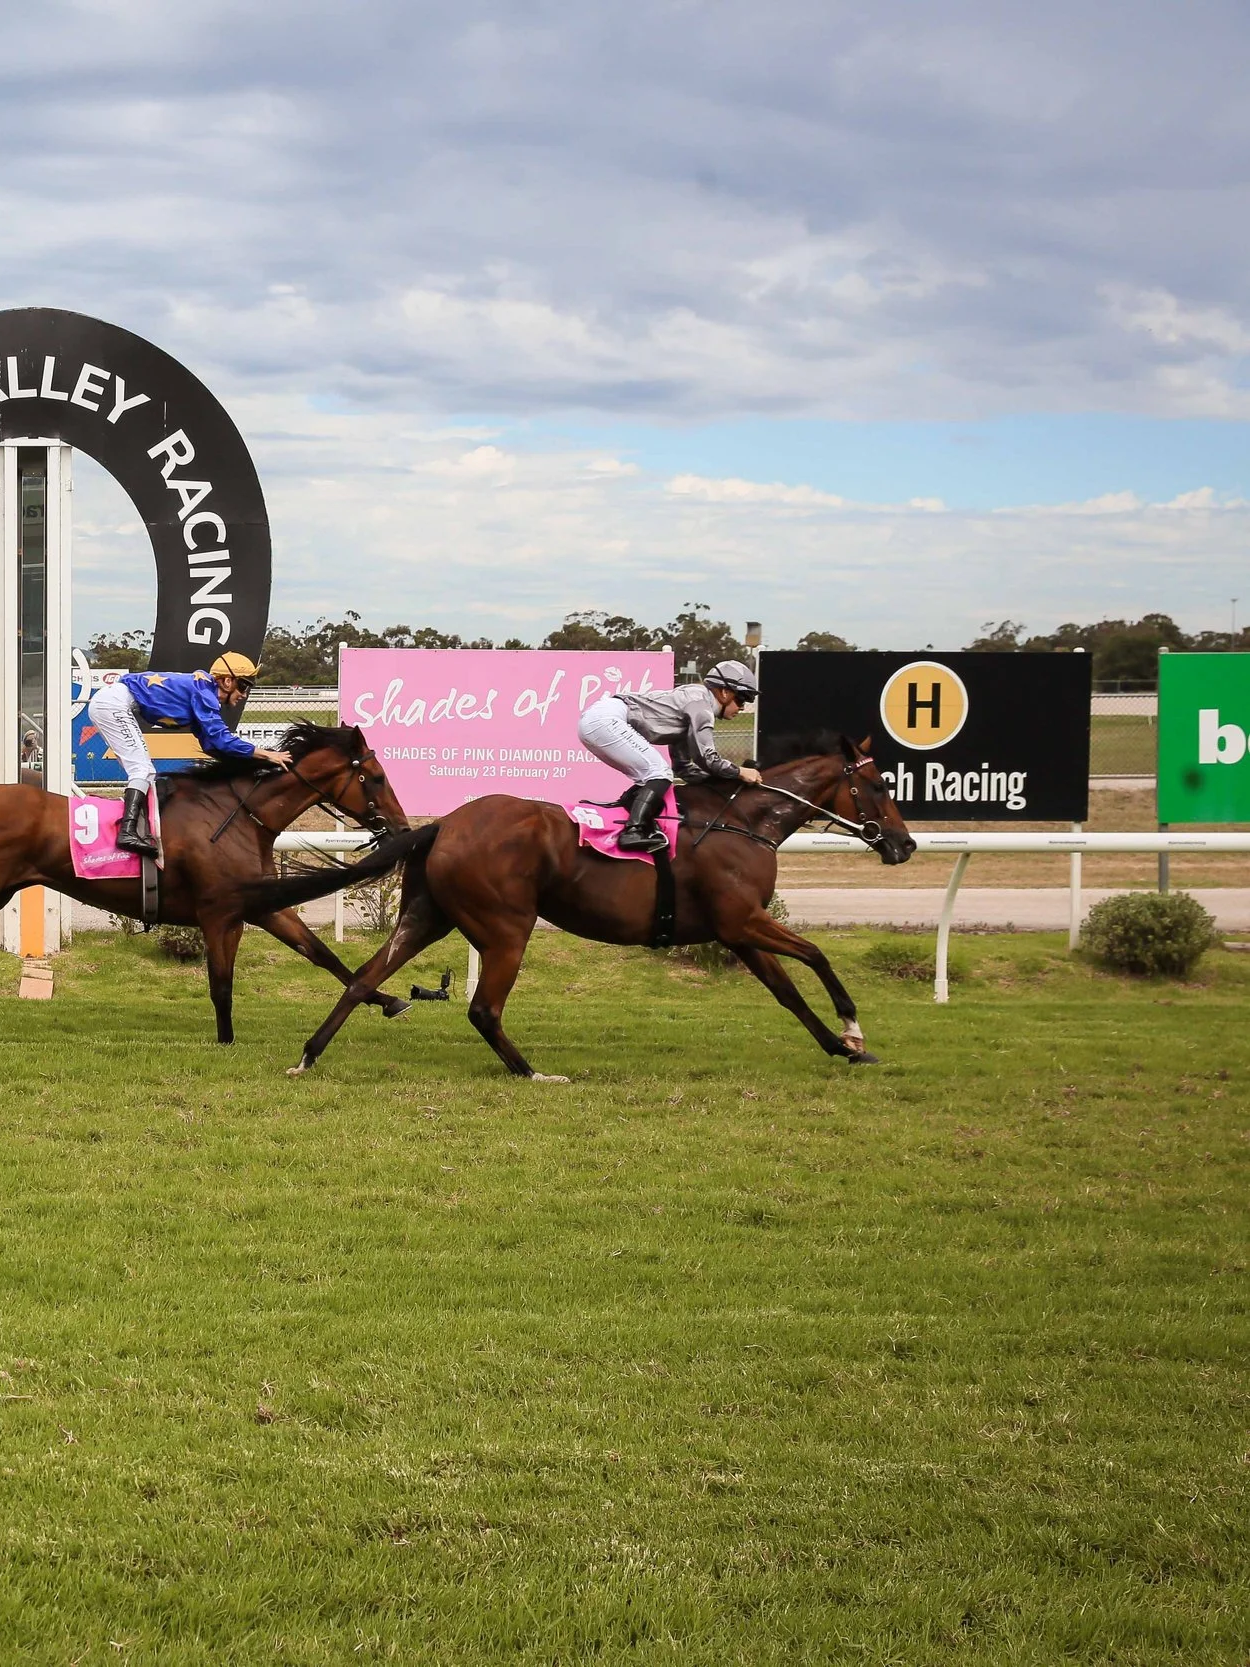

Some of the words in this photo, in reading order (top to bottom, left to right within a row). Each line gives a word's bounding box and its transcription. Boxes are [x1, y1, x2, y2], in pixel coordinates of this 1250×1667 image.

[146, 428, 233, 646] RACING
[513, 669, 566, 727] of
[907, 682, 942, 729] H
[383, 746, 437, 760] SHADES
[442, 748, 459, 761] OF
[464, 748, 495, 761] PINK
[499, 749, 562, 762] DIAMOND
[1199, 709, 1250, 765] b
[429, 764, 480, 779] Saturday
[482, 766, 496, 777] 23
[500, 766, 549, 780] February
[552, 767, 573, 778] 20
[880, 762, 914, 801] ch
[924, 762, 1028, 811] Racing
[74, 804, 99, 845] 9
